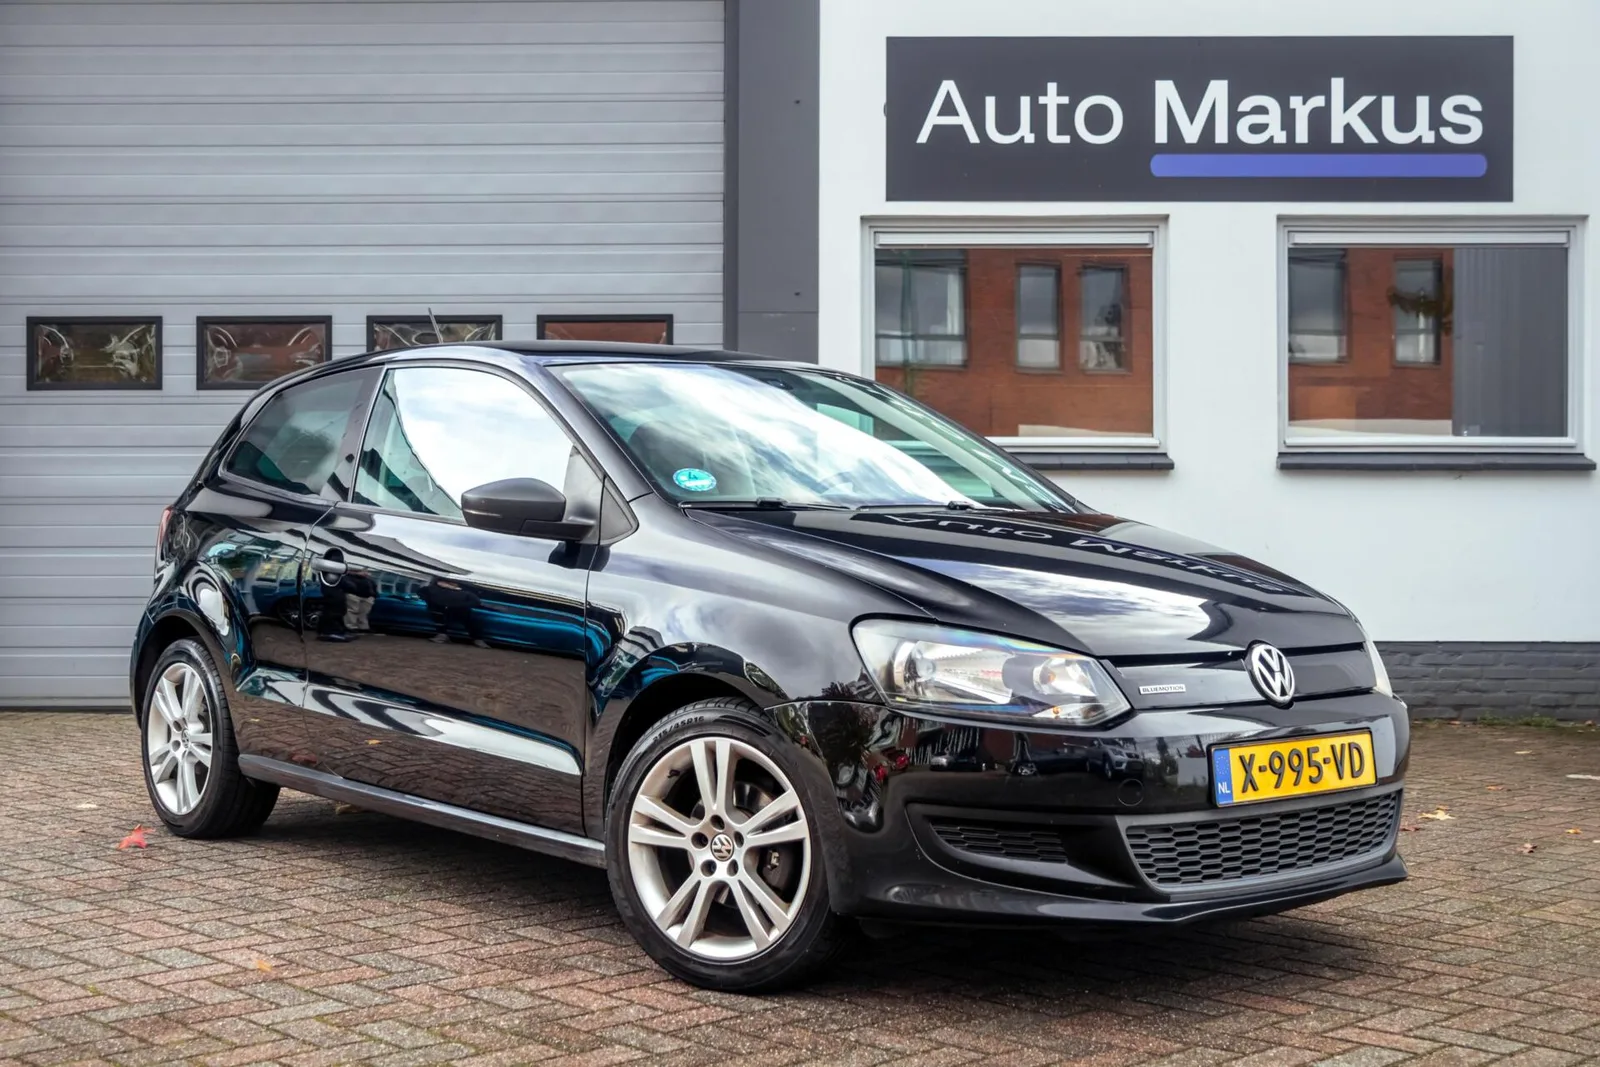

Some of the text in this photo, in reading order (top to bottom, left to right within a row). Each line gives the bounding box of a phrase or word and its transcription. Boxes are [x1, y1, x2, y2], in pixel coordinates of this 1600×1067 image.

[916, 76, 1483, 144] Auto Markus
[1217, 781, 1231, 794] NL
[1239, 741, 1365, 794] X-995-VD
